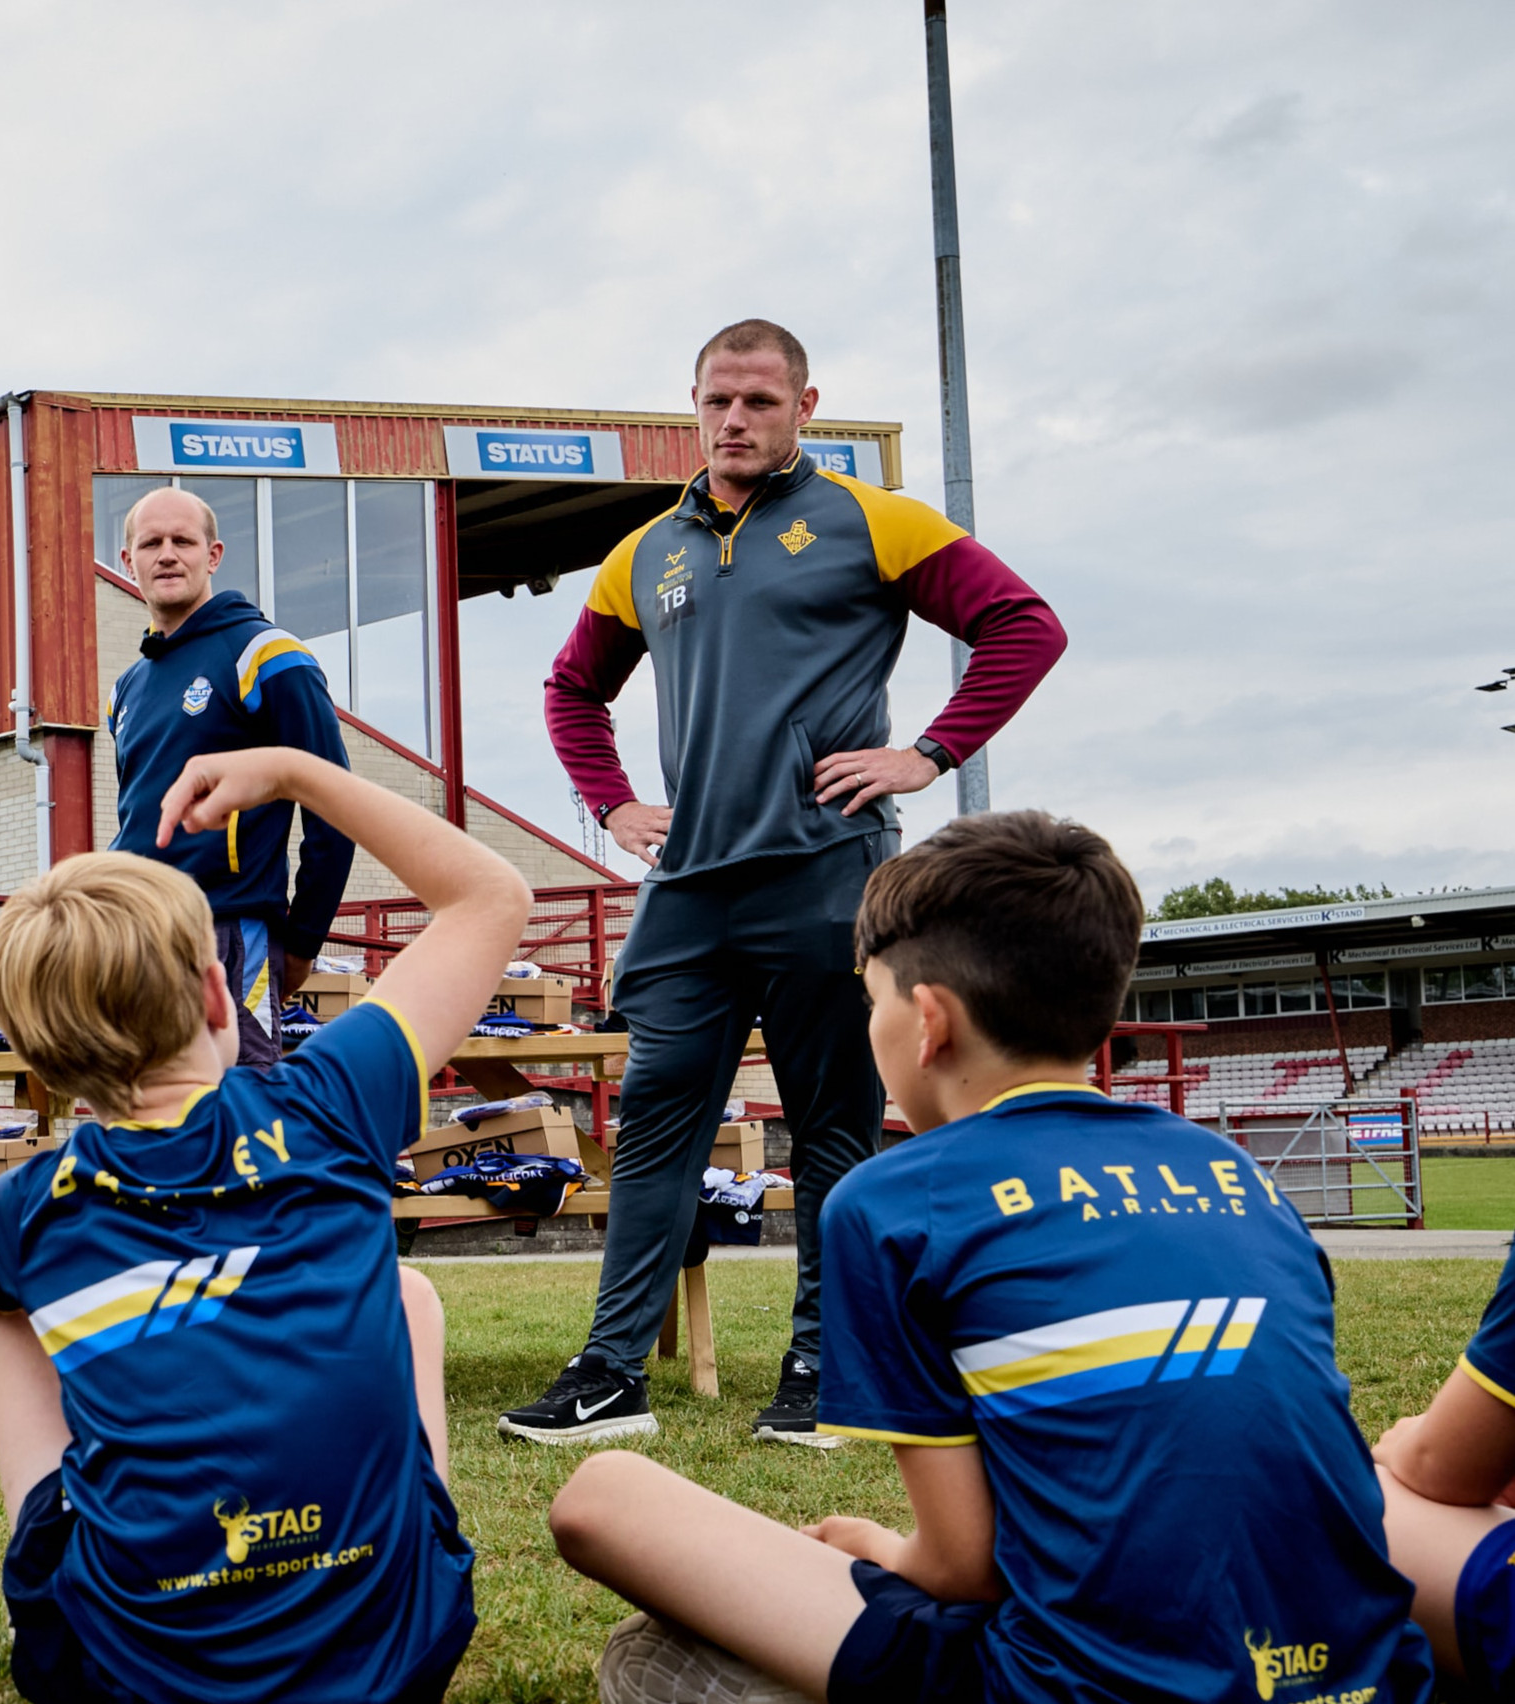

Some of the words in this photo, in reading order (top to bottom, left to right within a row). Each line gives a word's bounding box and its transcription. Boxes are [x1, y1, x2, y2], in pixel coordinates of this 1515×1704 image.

[661, 585, 687, 613] TB
[1163, 925, 1211, 936] MECHANICAL
[1213, 922, 1220, 931] &
[1221, 919, 1266, 931] ELECTRICAL
[1267, 915, 1304, 926] SERVICES
[1306, 912, 1321, 922] LTD
[1335, 909, 1363, 919] STAND
[1192, 963, 1230, 972] Mechanical
[1271, 957, 1299, 965] Services
[1300, 955, 1313, 963] Ltd
[1348, 949, 1389, 959] Mechanical
[1433, 942, 1465, 951] Services
[1465, 940, 1478, 948] Ltd
[991, 1160, 1281, 1217] BATLEY
[1082, 1198, 1246, 1223] A.R.L.F.C
[242, 1504, 323, 1544] STAG
[157, 1544, 375, 1593] www.stag-sports.com
[1266, 1643, 1329, 1680] STAG
